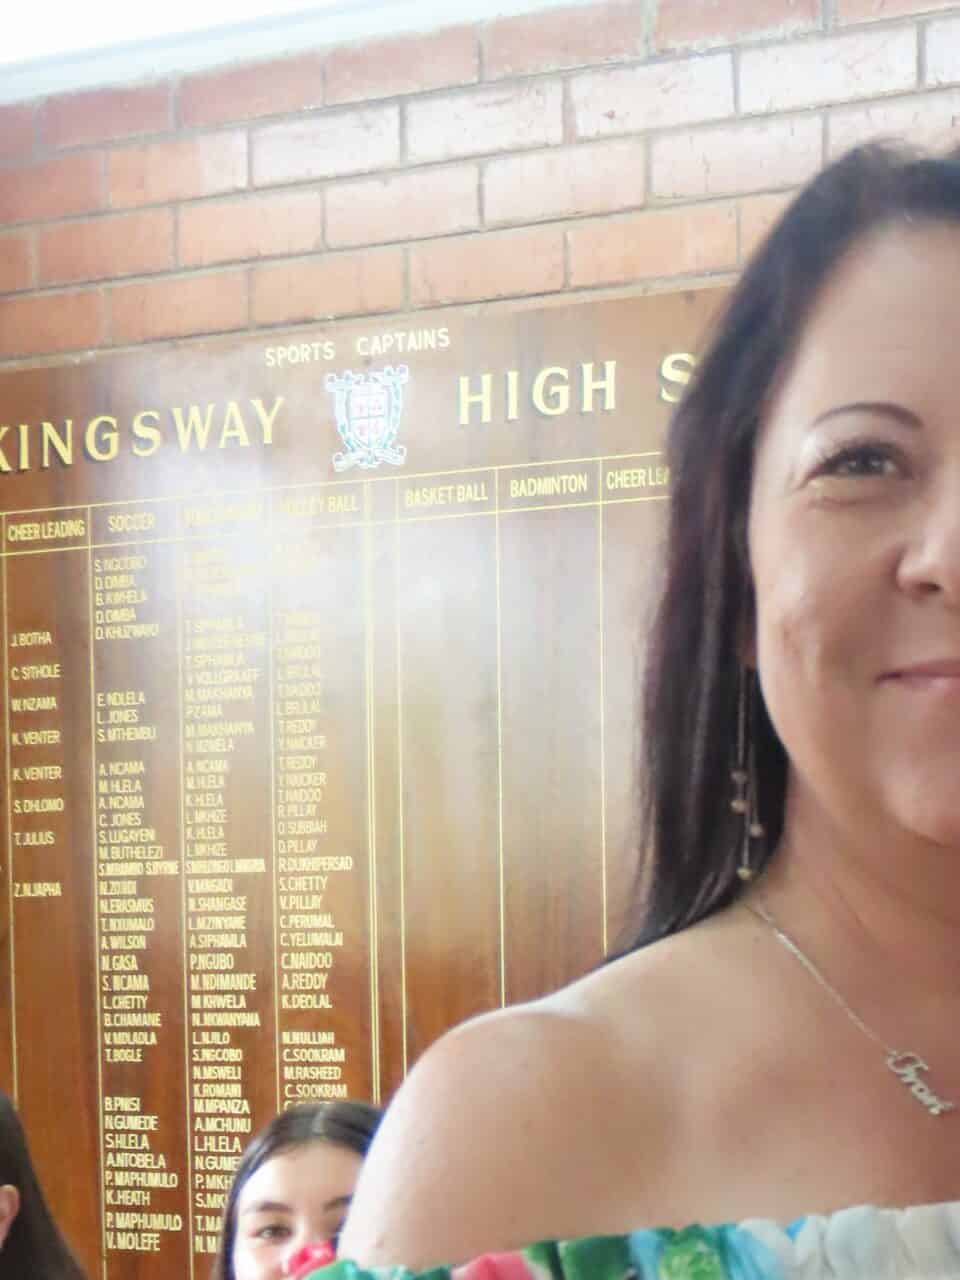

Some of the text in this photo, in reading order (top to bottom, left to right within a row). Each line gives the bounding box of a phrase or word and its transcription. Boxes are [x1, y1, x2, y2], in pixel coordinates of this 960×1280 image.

[265, 328, 450, 368] SPORTS CAPTAINS
[458, 360, 617, 425] HIGH
[510, 473, 588, 498] BADMINTON
[606, 467, 646, 490] CHEER
[327, 494, 358, 513] BALL
[406, 481, 488, 507] BASKET BALL
[42, 519, 85, 538] LEADING
